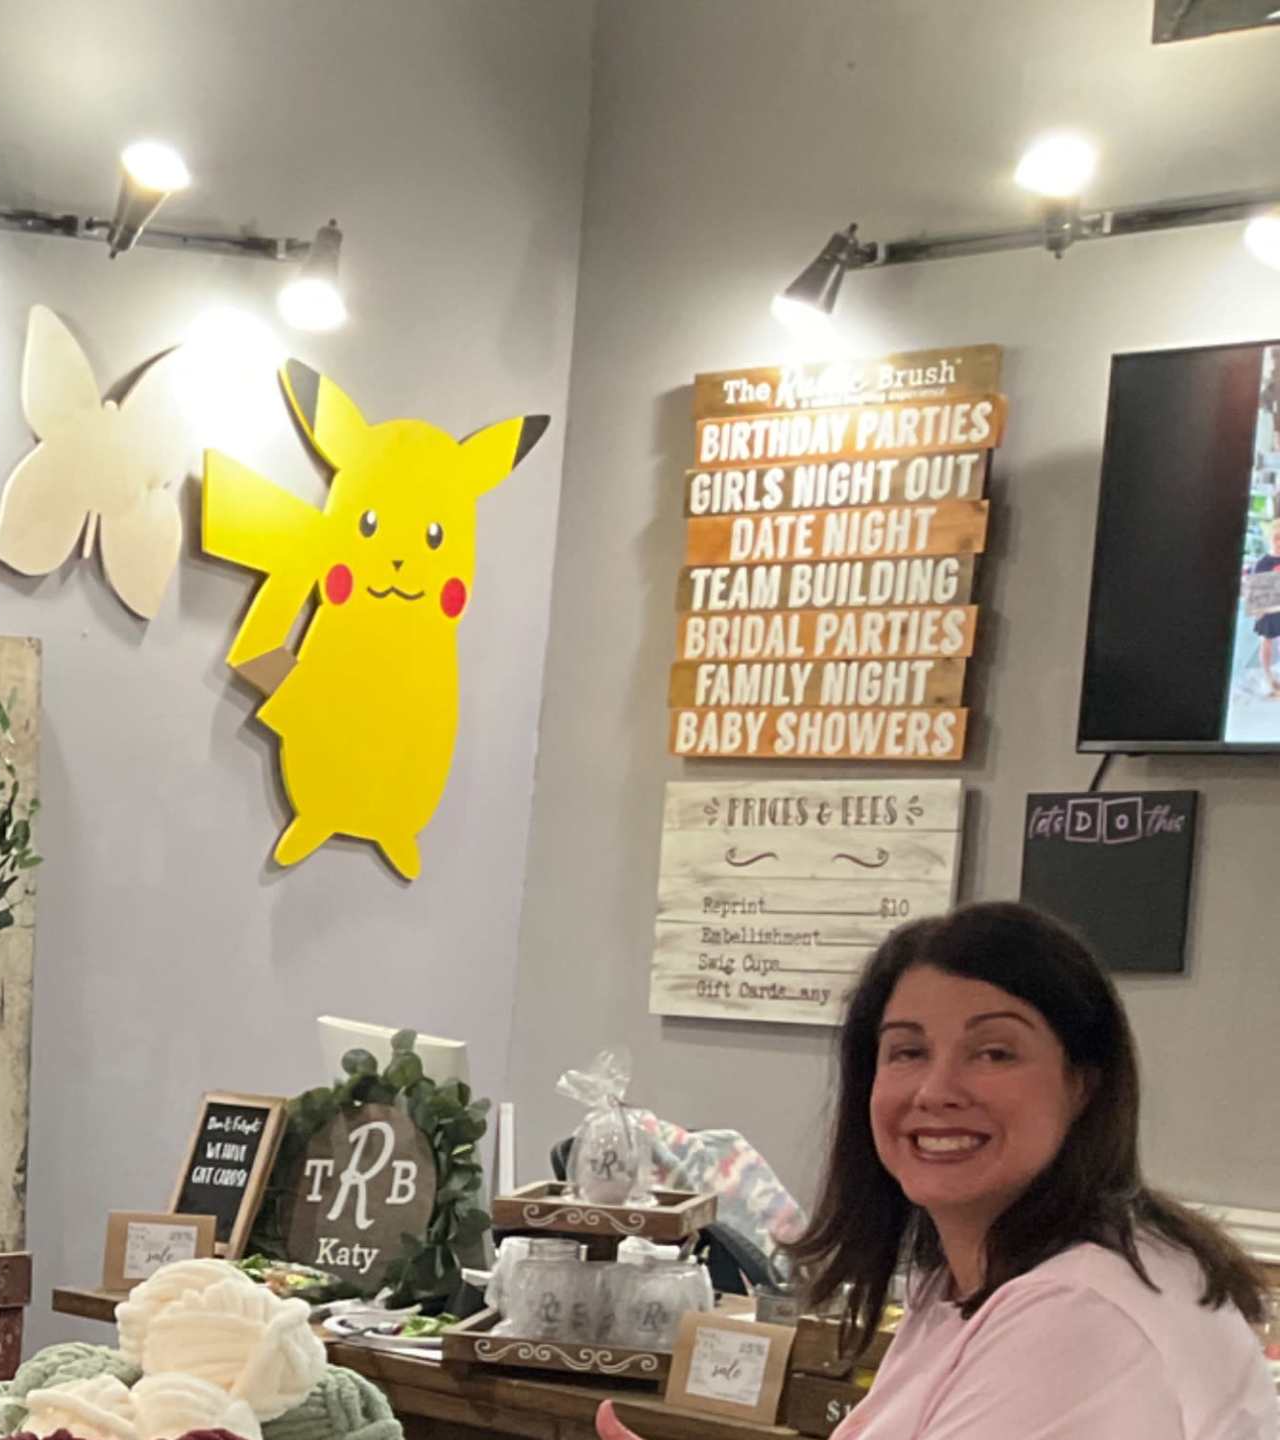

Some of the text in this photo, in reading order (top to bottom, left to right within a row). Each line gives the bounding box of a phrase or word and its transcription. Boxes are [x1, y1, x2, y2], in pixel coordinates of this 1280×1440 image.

[723, 378, 770, 405] The
[878, 361, 956, 392] Brush
[700, 401, 994, 464] BIRTHDAY PARTIES
[689, 454, 980, 515] GIRLS NIGHT OUT
[729, 506, 937, 562] DATE NIGHT
[690, 558, 961, 612] TEAM BUILDING
[683, 609, 967, 661] BRIDAL PARTIES
[695, 660, 935, 707] FAMILY NIGHT
[674, 711, 958, 757] BABY SHOWERS
[726, 796, 810, 828] PRICES
[816, 801, 833, 827] &
[1143, 804, 1186, 837] this
[702, 896, 911, 918] Reprint $10
[700, 926, 821, 948] Embellishment
[742, 954, 782, 976] Cups
[696, 979, 832, 1007] Gift Cards any
[315, 1237, 381, 1274] Katy
